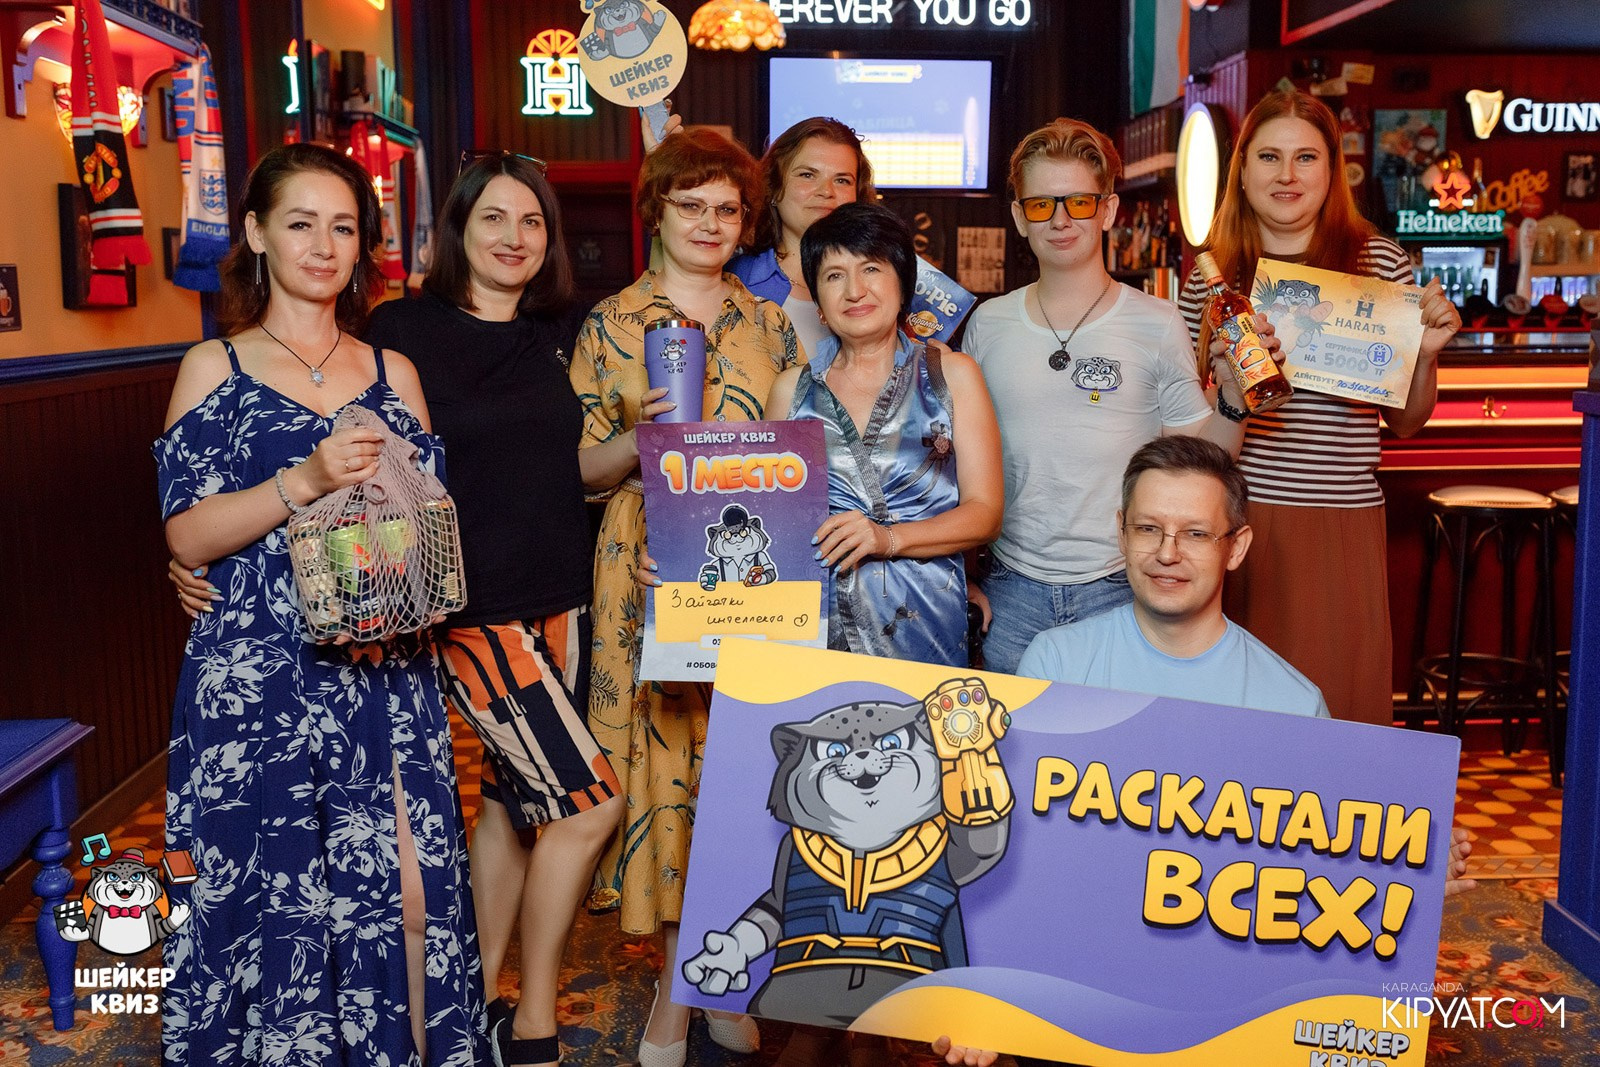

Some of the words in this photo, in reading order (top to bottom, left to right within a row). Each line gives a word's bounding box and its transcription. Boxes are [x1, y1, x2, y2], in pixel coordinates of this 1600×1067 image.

[913, 0, 976, 26] YOU
[988, 0, 1031, 26] GO
[609, 53, 673, 88] ШЕЙКЕР
[626, 75, 670, 100] КВИЗ
[1396, 210, 1503, 233] Heineken
[1304, 354, 1316, 363] НА
[1324, 353, 1369, 373] 5000
[1294, 371, 1335, 385] ДЕЙСТВУЕТ
[684, 430, 736, 444] ШЕЙКЕР
[740, 432, 776, 443] КВИЗ
[662, 453, 686, 492] 1
[693, 454, 805, 491] МЕСТО
[1032, 756, 1432, 868] РАСКАТАЛИ
[1142, 849, 1415, 962] ВСЕХ!
[1294, 1019, 1410, 1059] ШЕЙКЕР
